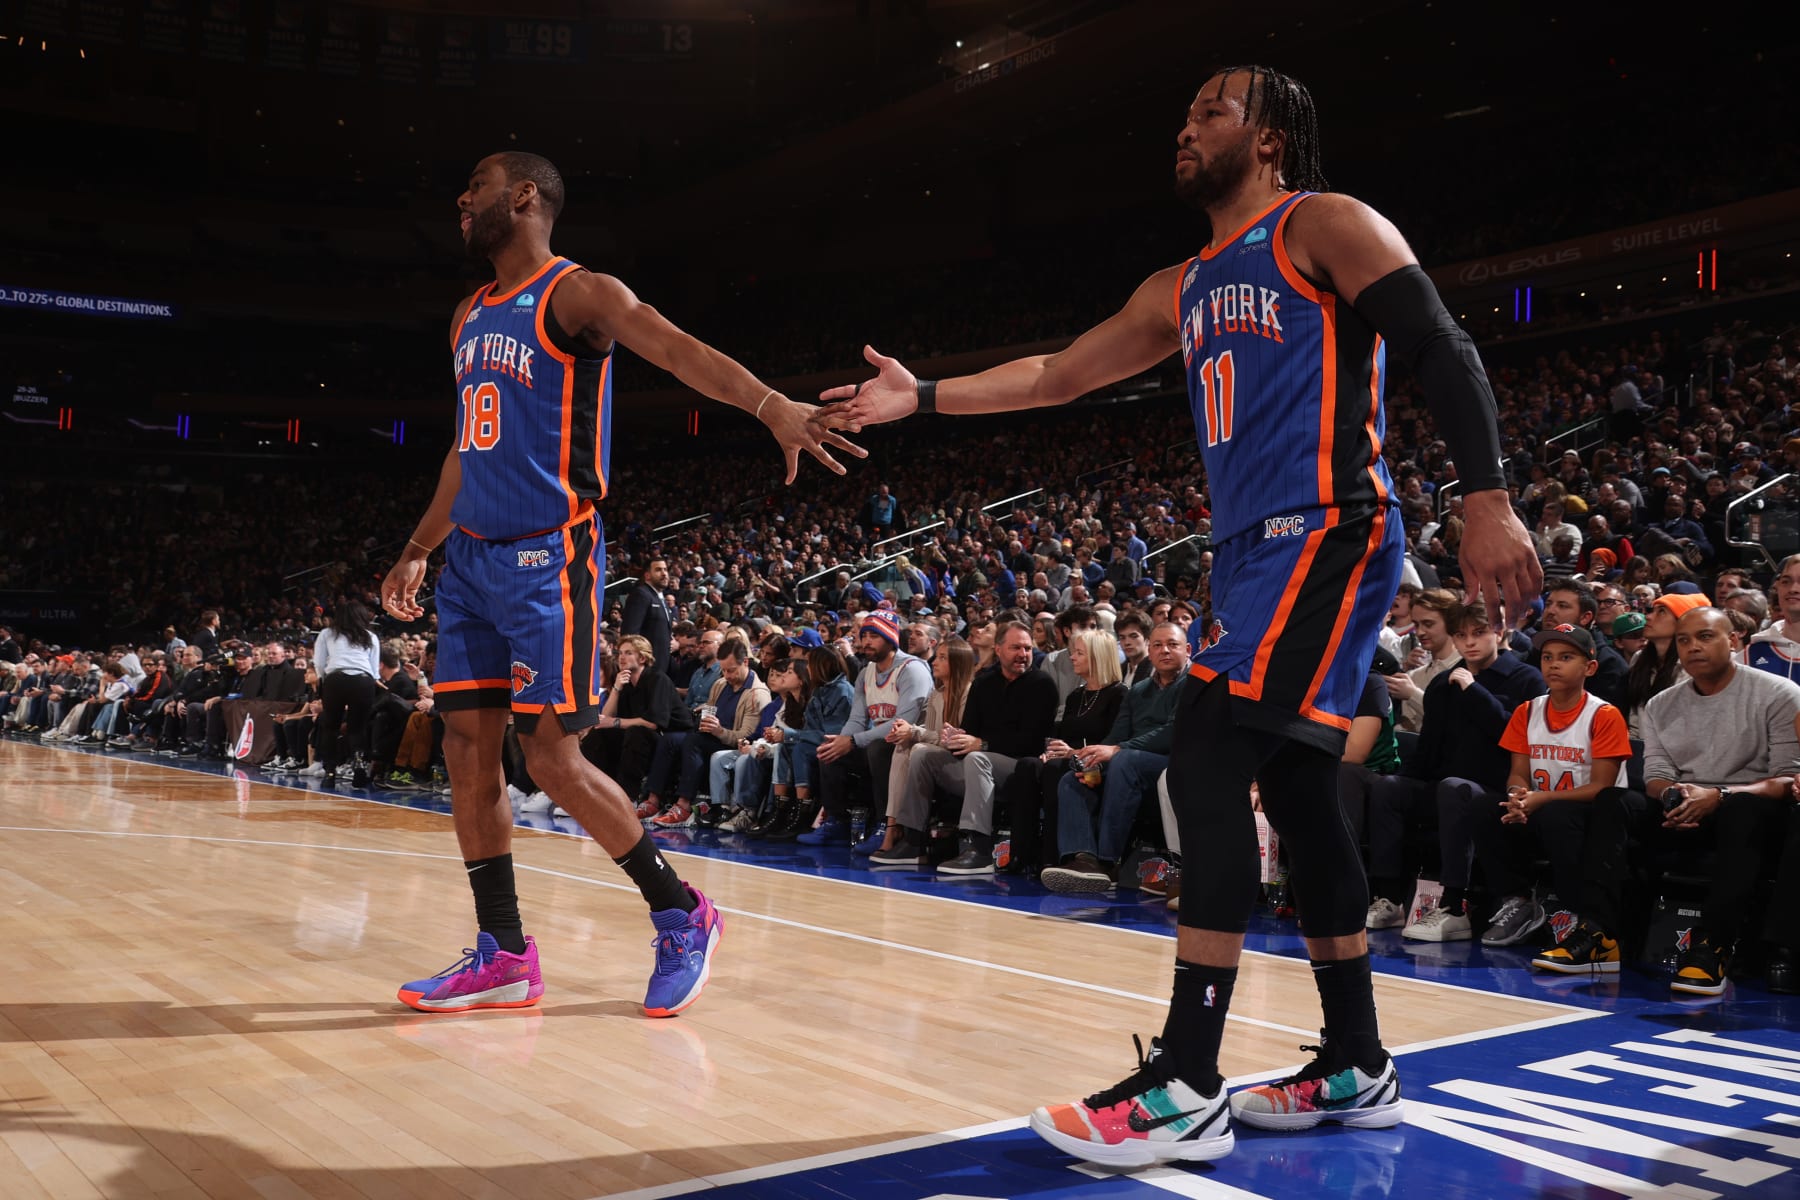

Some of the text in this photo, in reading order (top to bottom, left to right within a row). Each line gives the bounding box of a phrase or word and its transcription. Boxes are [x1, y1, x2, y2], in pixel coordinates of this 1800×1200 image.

[661, 23, 693, 52] 13
[955, 64, 1000, 93] CHASE
[1612, 217, 1725, 252] SUITE LEVEL
[1492, 247, 1583, 276] LEXUS
[28, 292, 54, 305] 275+
[55, 295, 96, 311] GLOBAL
[97, 299, 173, 317] DESTINATIONS.
[1209, 283, 1284, 343] YORK
[481, 333, 535, 389] YORK
[1200, 349, 1235, 448] 11
[458, 381, 501, 452] 18
[1264, 514, 1304, 539] NYC
[517, 549, 549, 567] NYC
[39, 608, 77, 619] ULTRA
[1533, 768, 1575, 792] 34
